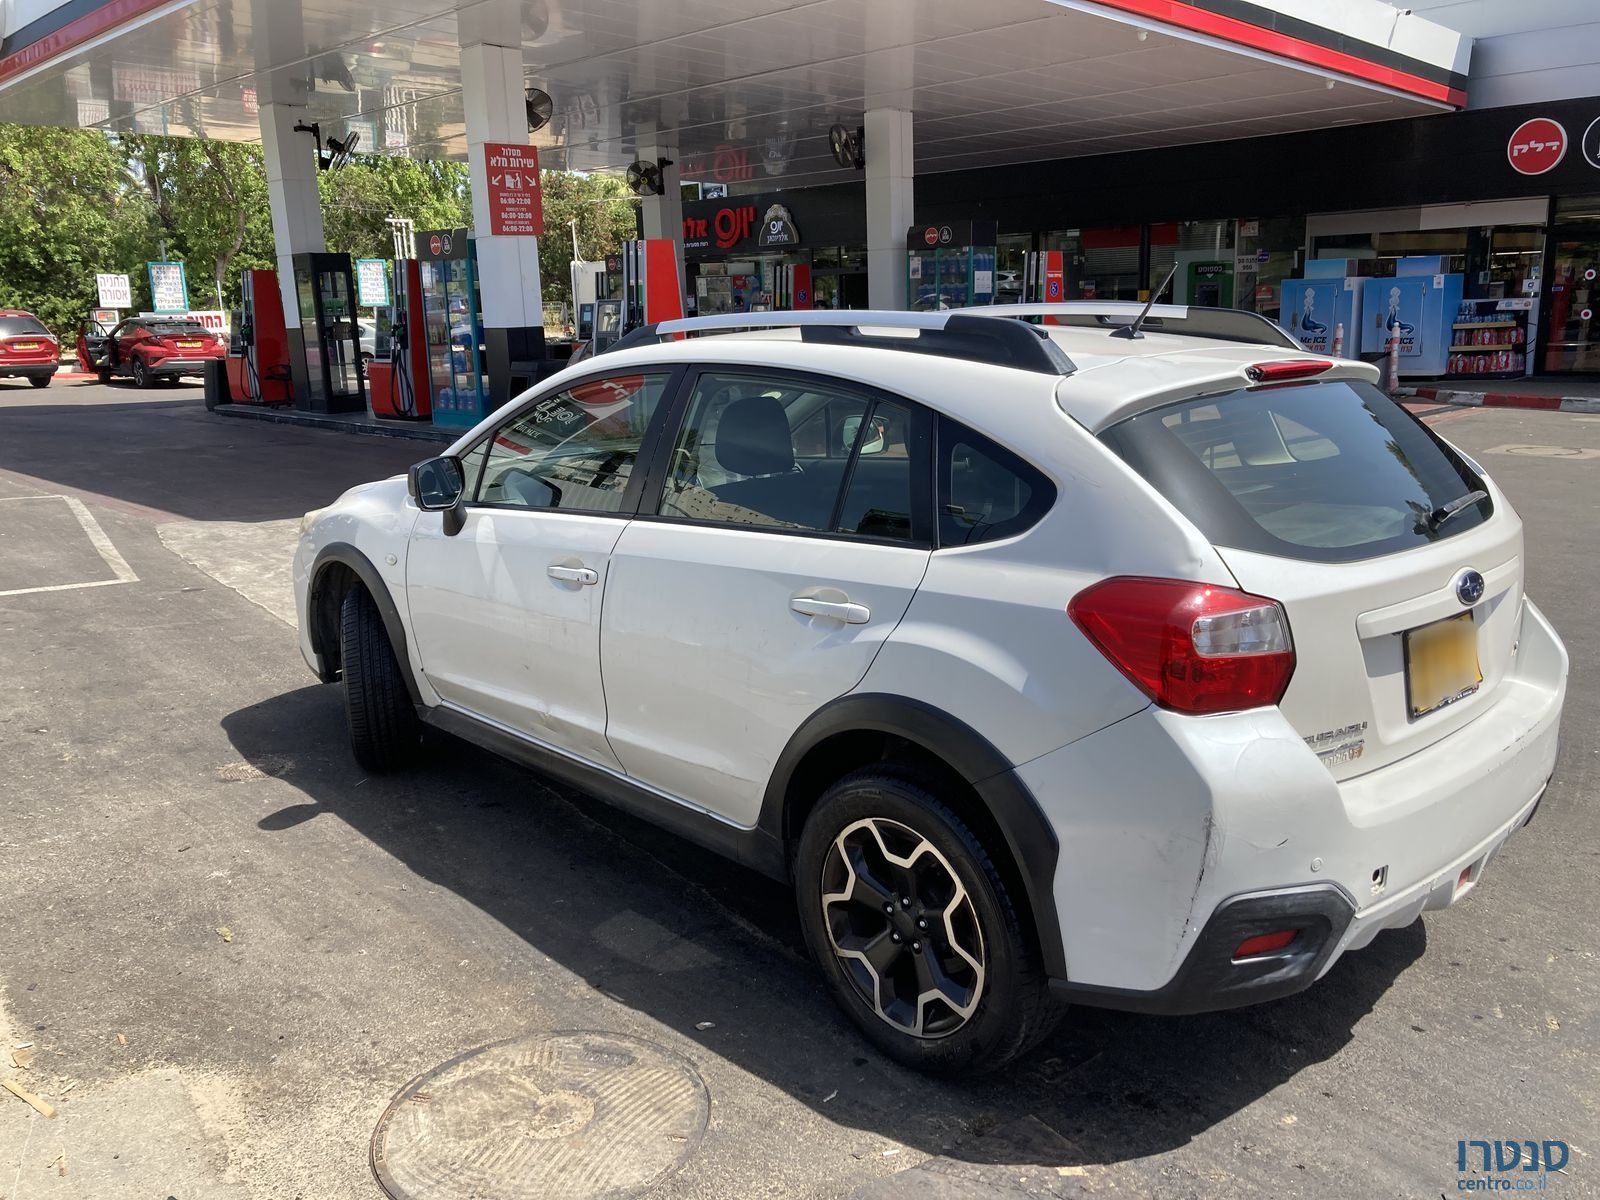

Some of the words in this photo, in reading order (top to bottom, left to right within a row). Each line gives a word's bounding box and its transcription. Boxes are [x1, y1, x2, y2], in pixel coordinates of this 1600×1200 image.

[502, 147, 521, 157] מסלול
[1513, 140, 1560, 157] דלק
[490, 155, 508, 167] מלא
[510, 157, 534, 168] שירות
[99, 276, 127, 288] החניה
[101, 289, 129, 301] אסורה
[1313, 336, 1327, 344] ICE
